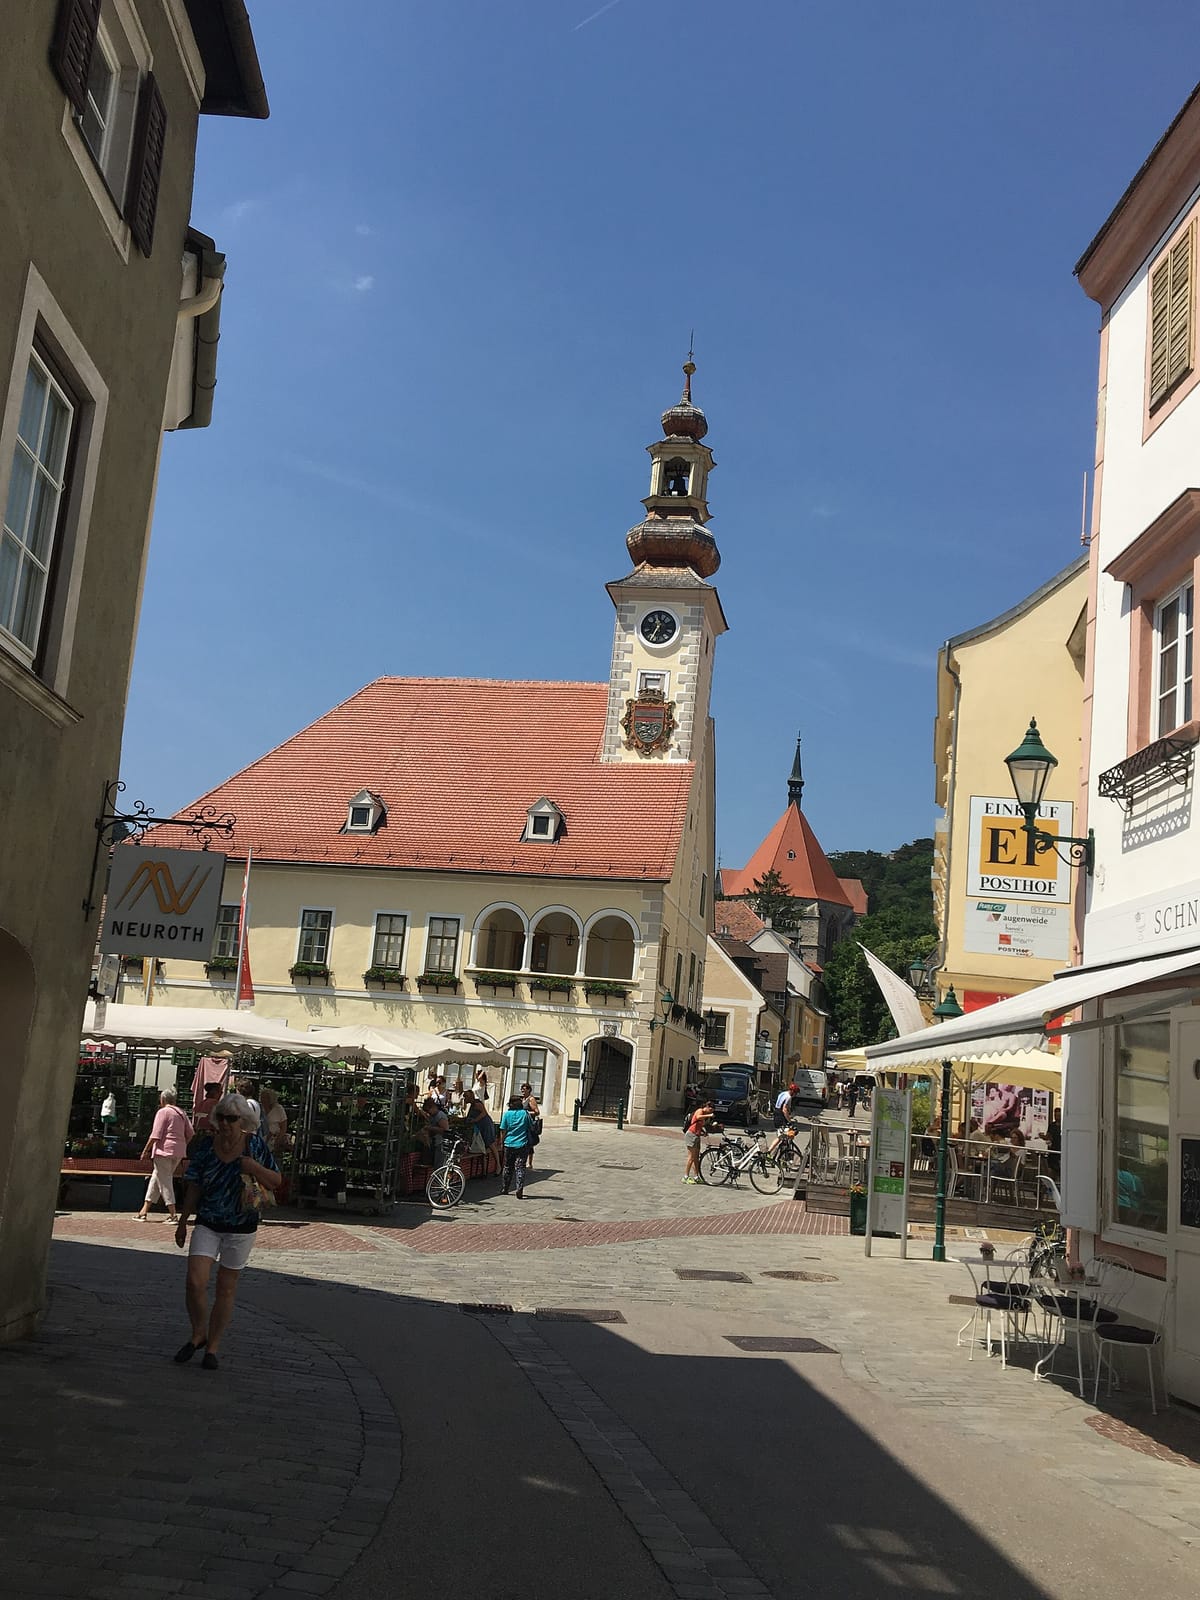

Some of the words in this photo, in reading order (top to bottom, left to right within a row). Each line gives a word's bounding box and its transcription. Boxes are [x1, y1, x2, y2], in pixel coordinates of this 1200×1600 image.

[985, 802, 1058, 818] EINKUF
[980, 876, 1057, 893] POSTHOF
[1003, 915, 1048, 924] augenweide
[1154, 899, 1199, 934] SCHN
[112, 920, 204, 942] NEUROTH
